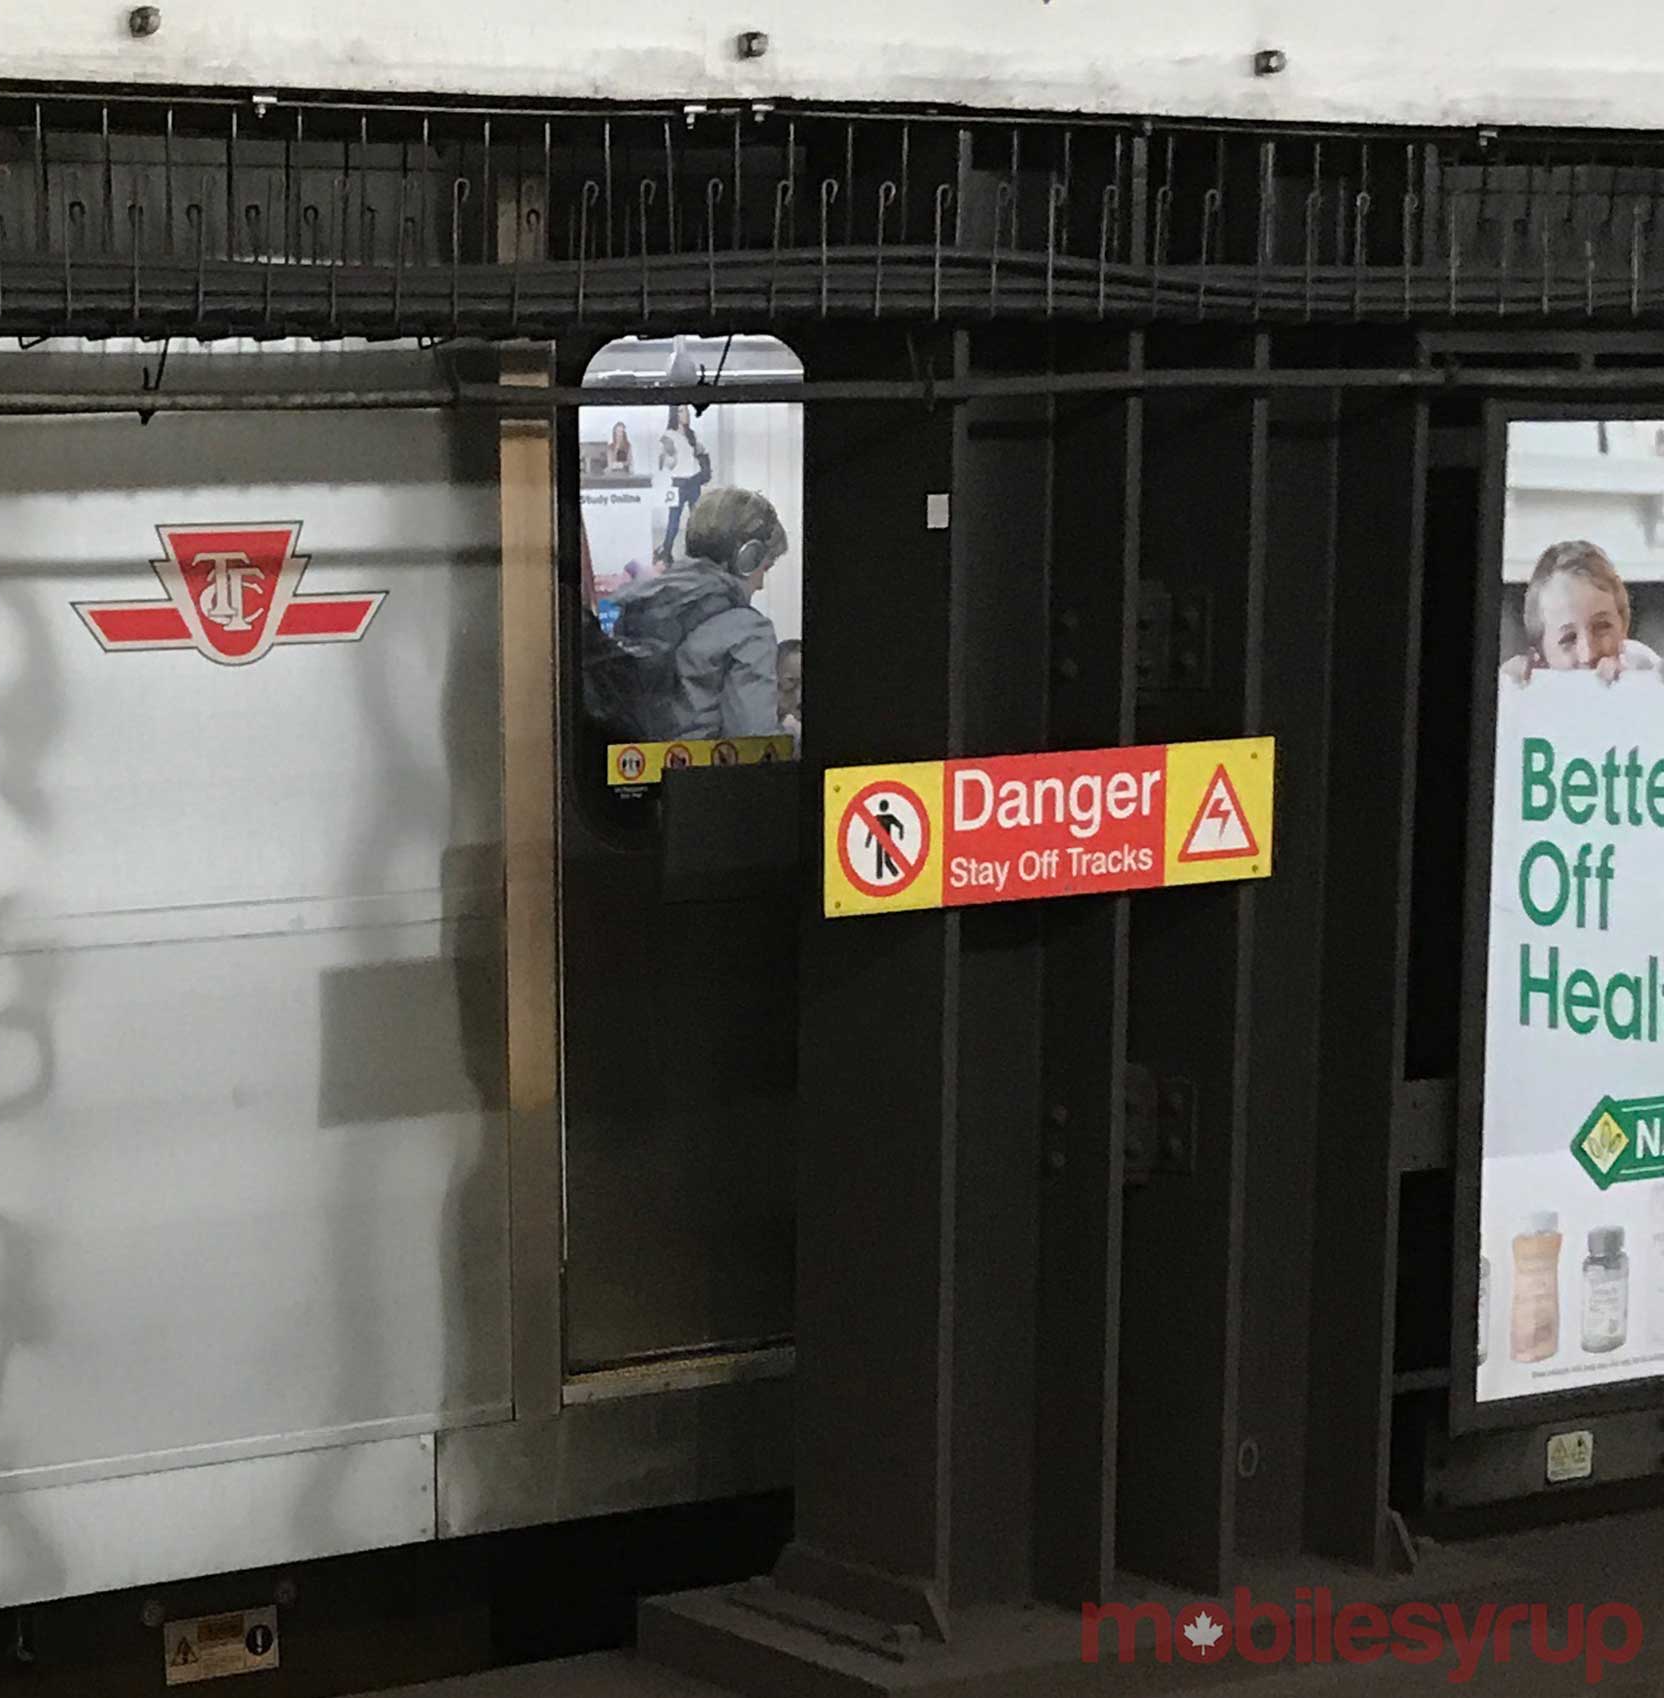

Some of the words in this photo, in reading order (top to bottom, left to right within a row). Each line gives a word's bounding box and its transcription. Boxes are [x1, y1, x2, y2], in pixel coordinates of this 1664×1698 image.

[610, 494, 641, 505] Online
[953, 768, 1162, 838] Danger
[950, 856, 1010, 893] Stay
[1018, 850, 1059, 882] Off
[1066, 843, 1154, 879] Tracks
[1519, 840, 1615, 930] Off
[1519, 943, 1664, 1042] Heal
[1637, 1117, 1664, 1159] N
